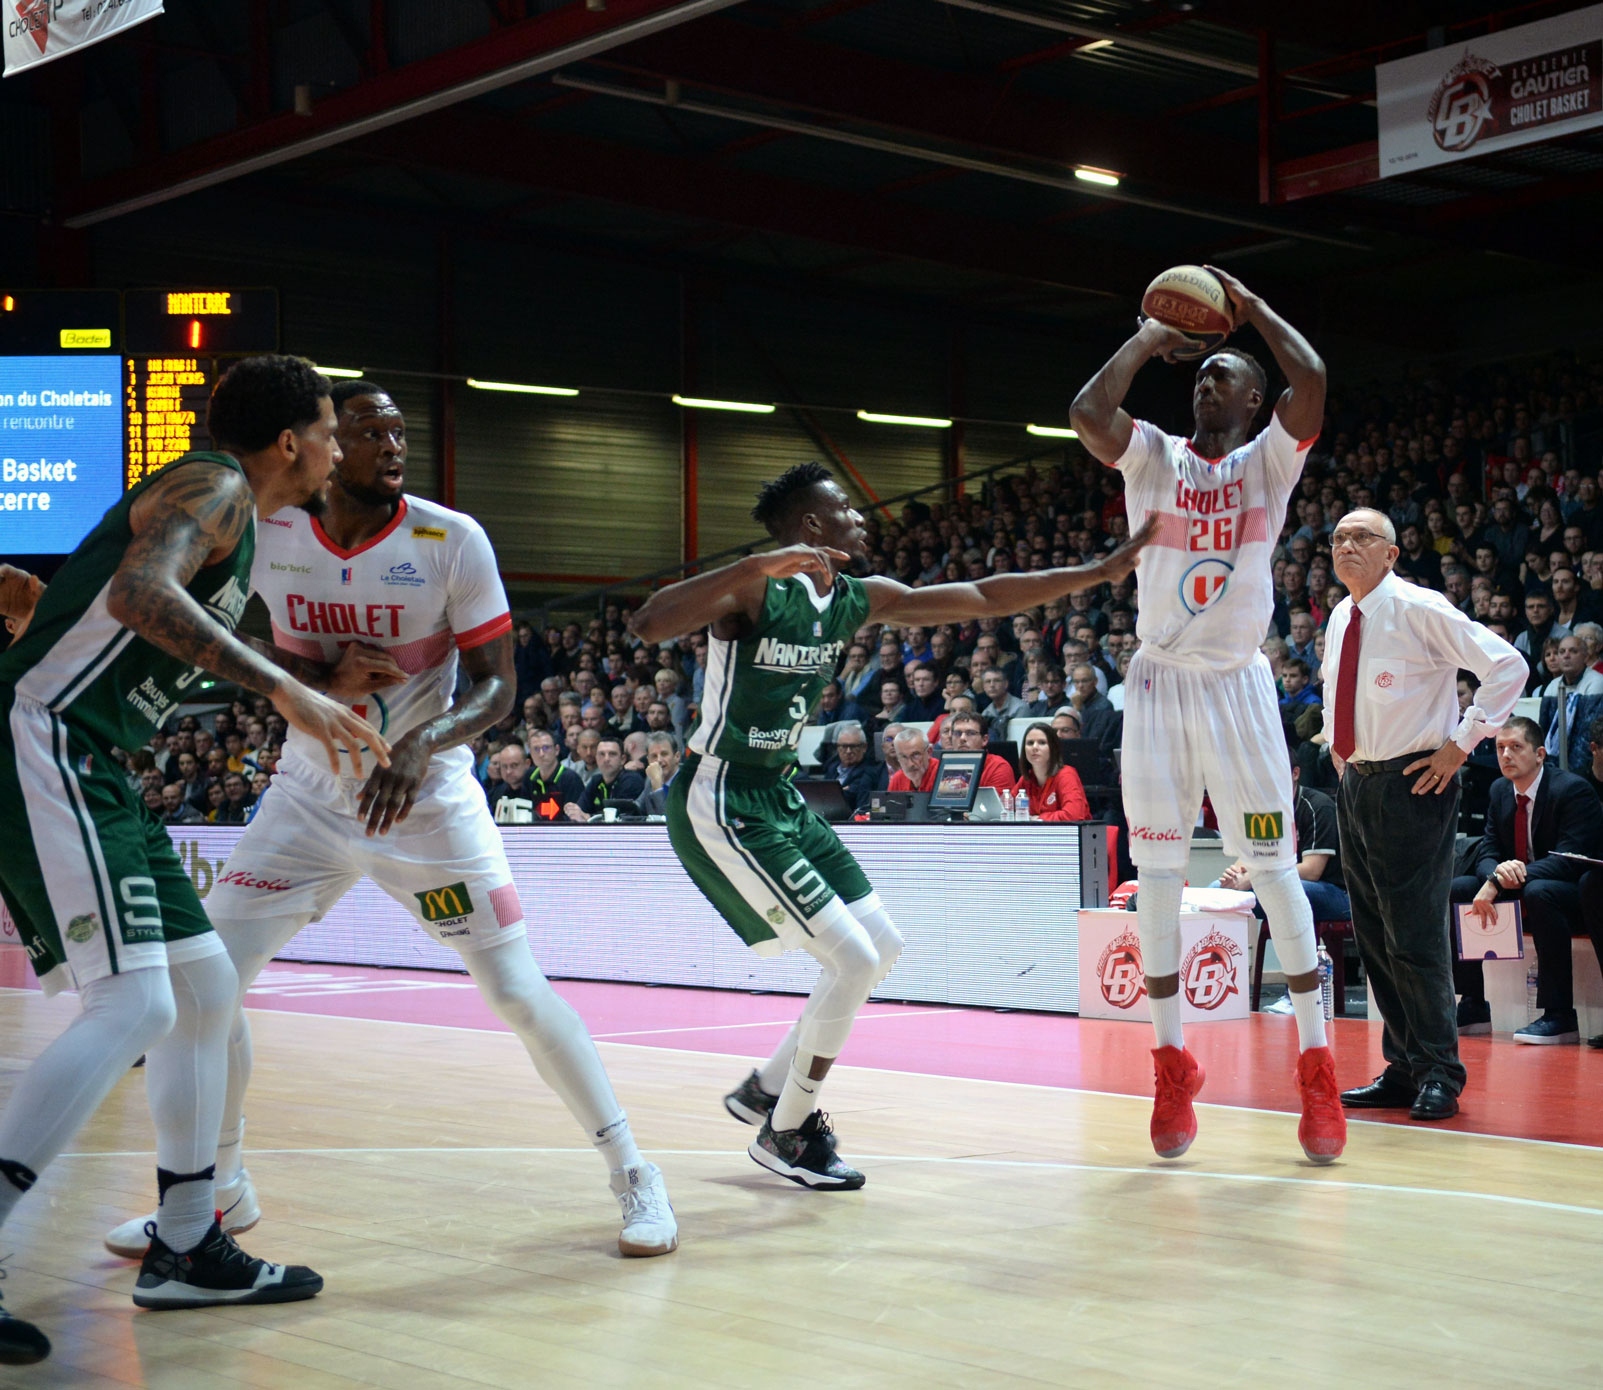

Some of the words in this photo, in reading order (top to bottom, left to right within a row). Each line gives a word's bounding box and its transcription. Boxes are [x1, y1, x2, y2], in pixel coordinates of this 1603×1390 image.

[9, 10, 47, 38] CHOLET
[1510, 99, 1549, 126] CHOLET
[1549, 88, 1590, 117] BASKET
[17, 390, 37, 407] du
[40, 389, 112, 407] Choletais
[3, 413, 75, 430] rencontre
[3, 458, 77, 482] Basket
[1190, 516, 1233, 552] 26
[286, 593, 405, 639] CHOLET
[1131, 826, 1183, 841] Nicoll
[1252, 840, 1279, 848] CHOLET
[217, 870, 293, 891] Nicoll
